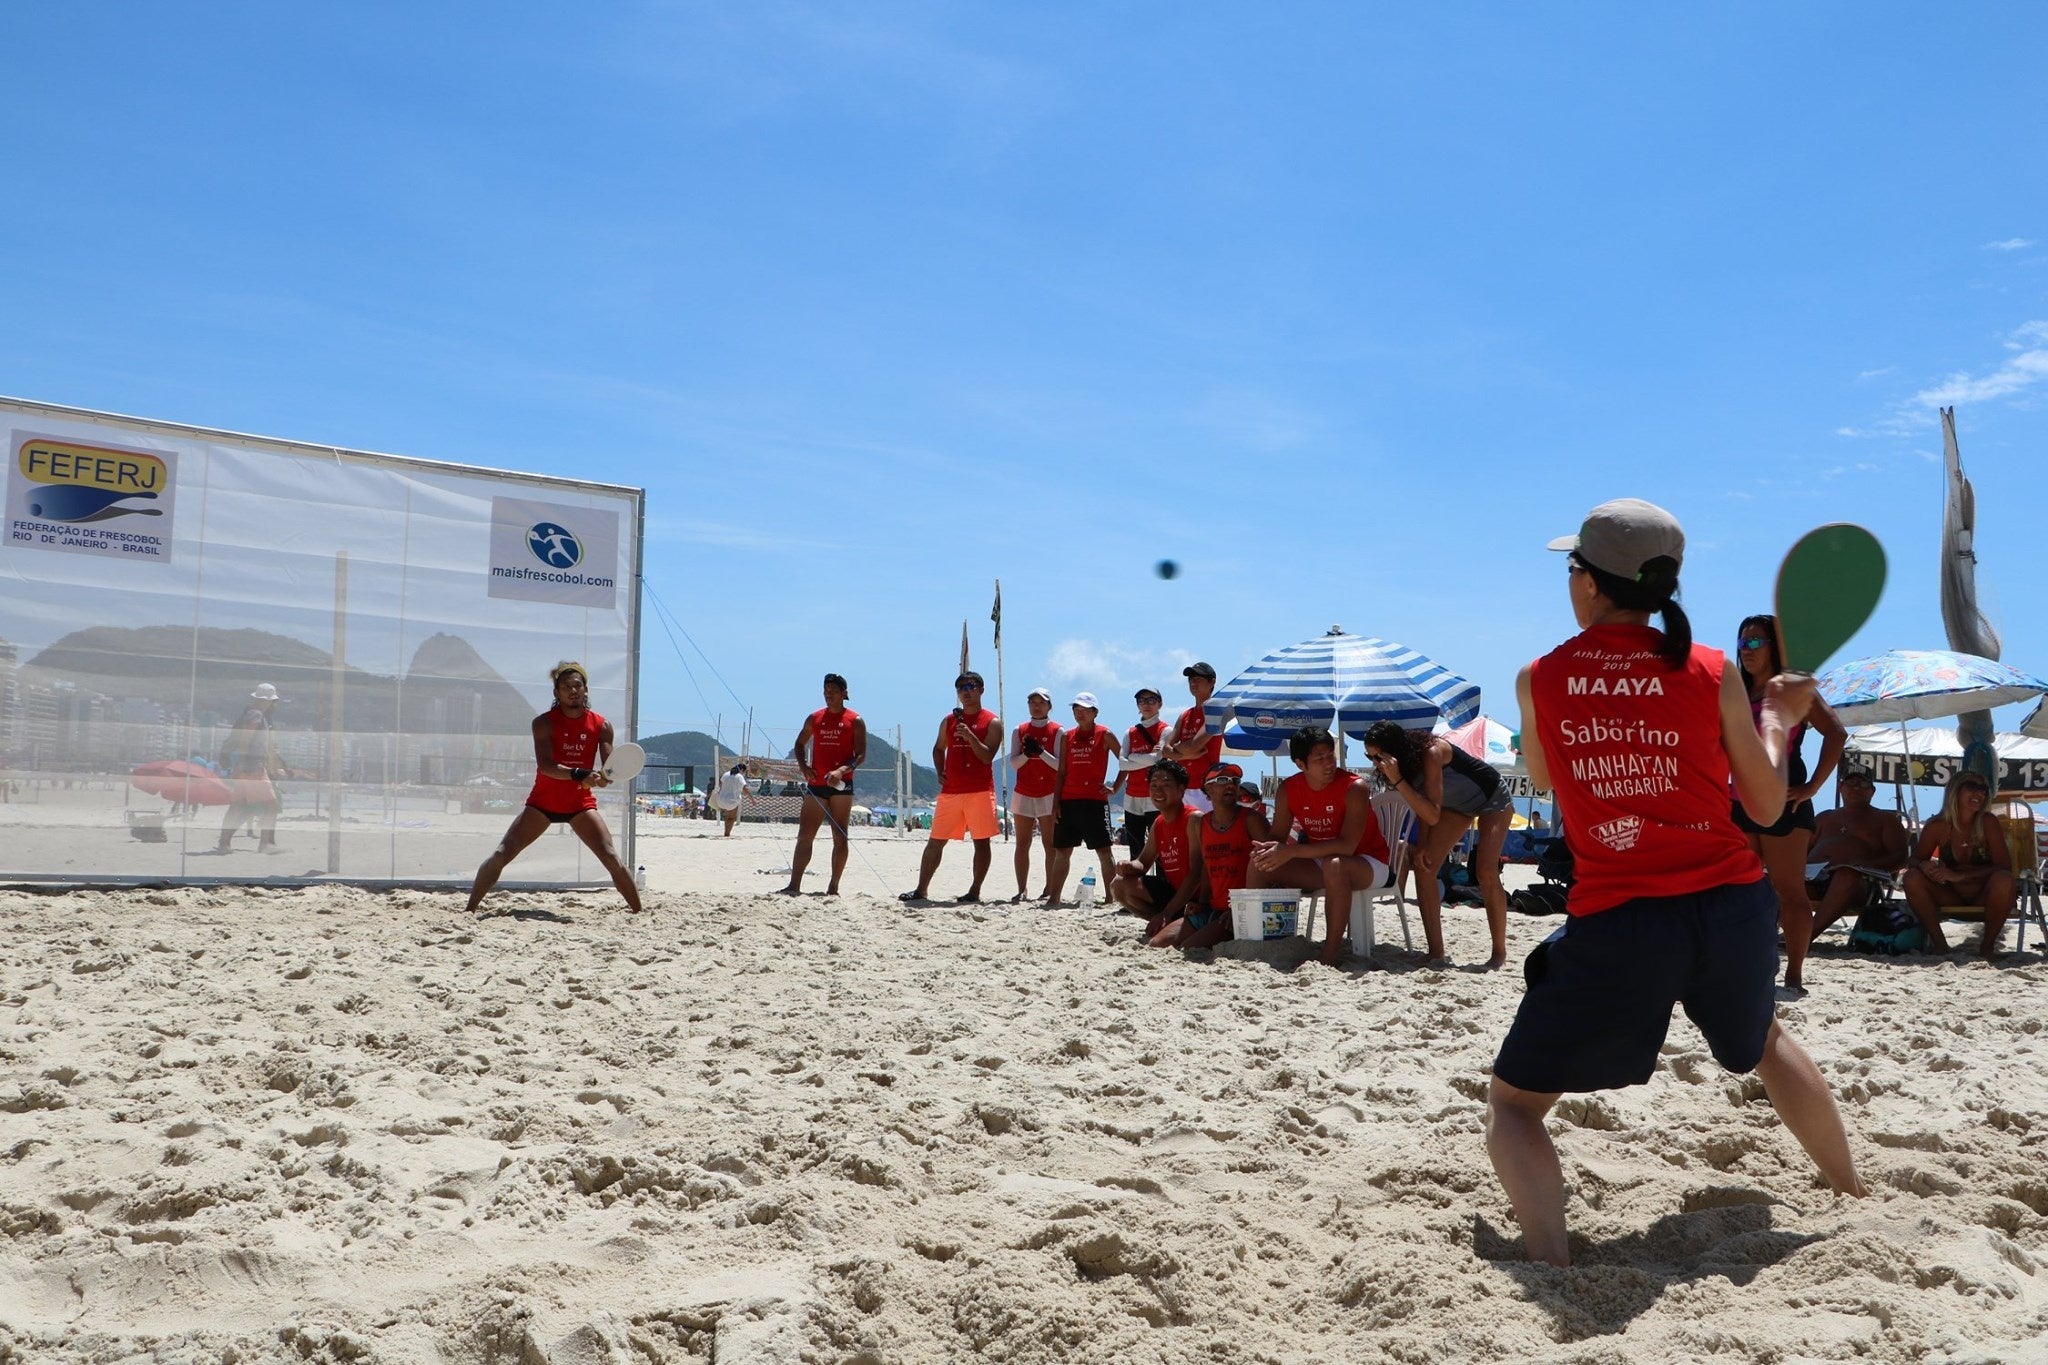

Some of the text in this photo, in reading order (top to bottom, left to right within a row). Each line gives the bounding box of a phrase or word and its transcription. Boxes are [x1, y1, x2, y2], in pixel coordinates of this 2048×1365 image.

[28, 449, 157, 489] FEFERJ
[12, 531, 33, 541] RIO
[41, 534, 56, 544] DE
[61, 537, 109, 550] JANEIRO
[122, 543, 160, 555] BRASIL
[13, 520, 162, 546] FEDERAÇÃO DE FRESCOBOL
[492, 566, 613, 588] maisfrescobol.com
[1602, 662, 1631, 670] 2019
[1567, 676, 1664, 696] MAAYA
[1560, 717, 1680, 747] Saborino
[2019, 762, 2048, 788] 13
